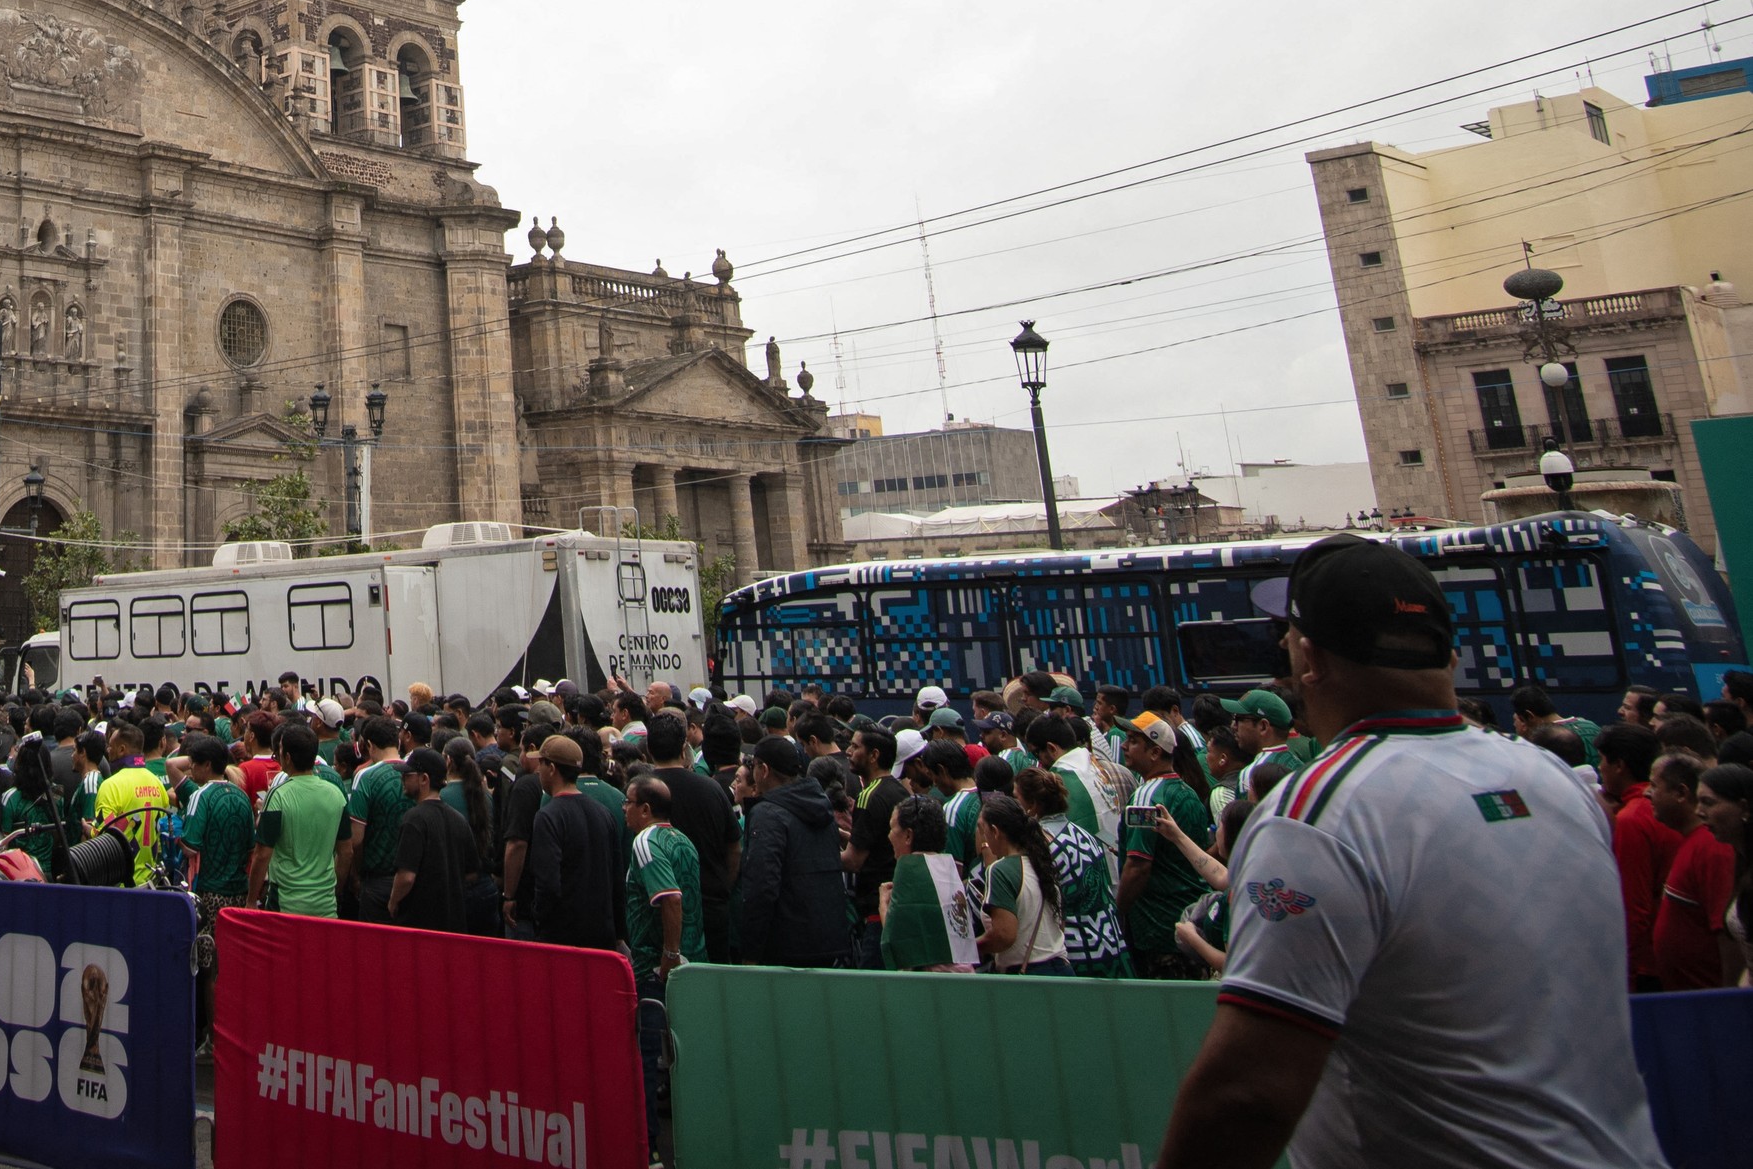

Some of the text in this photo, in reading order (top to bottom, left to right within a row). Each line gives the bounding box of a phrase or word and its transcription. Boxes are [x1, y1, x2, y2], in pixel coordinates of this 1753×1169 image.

[246, 675, 383, 700] MNDO
[135, 786, 161, 798] CAMPOS
[143, 802, 151, 846] 1
[76, 1078, 108, 1102] FIFA
[258, 1042, 588, 1169] #FIFAFanFestival
